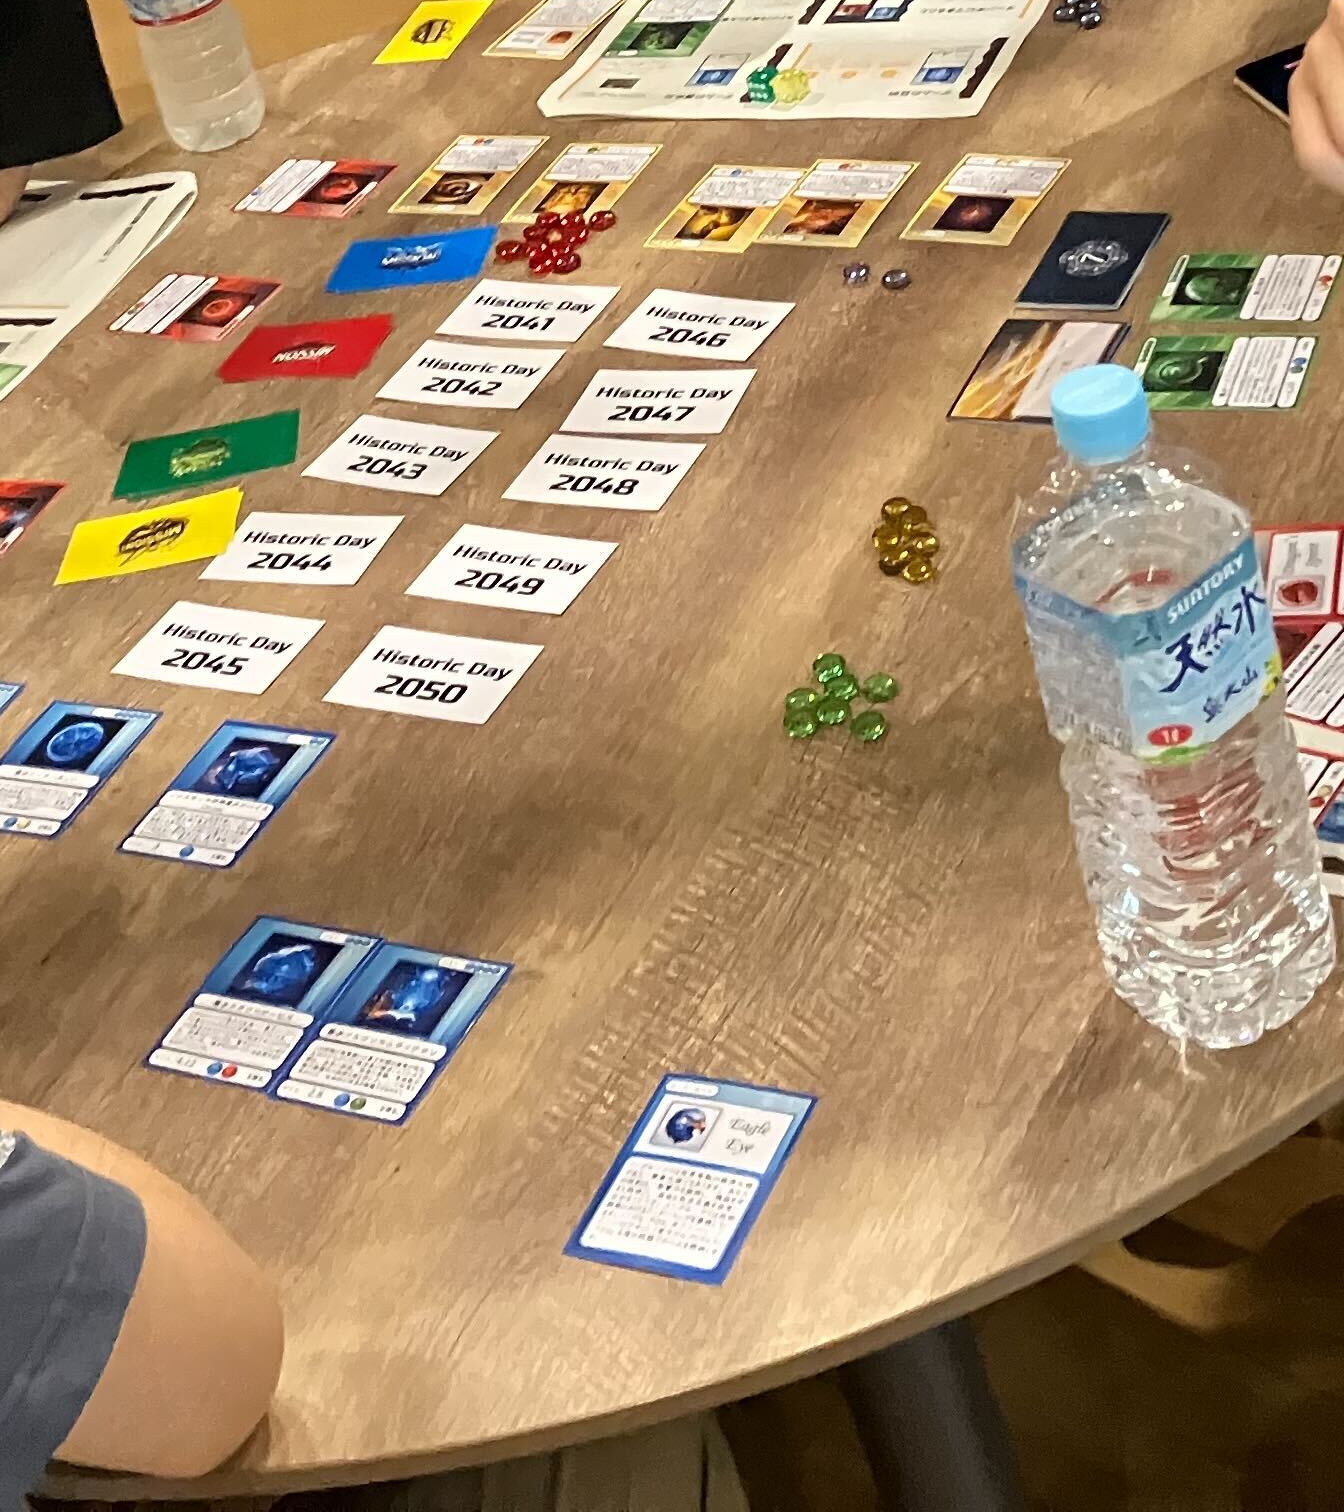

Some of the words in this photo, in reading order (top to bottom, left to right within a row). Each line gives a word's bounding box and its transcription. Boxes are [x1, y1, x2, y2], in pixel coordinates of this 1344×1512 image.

[474, 295, 553, 311] Historic
[556, 300, 595, 314] Day
[481, 313, 556, 332] 2041
[646, 306, 727, 326] Historic
[728, 316, 769, 331] Day
[648, 325, 731, 348] 2046
[417, 357, 497, 374] Historic
[500, 364, 541, 378] Day
[421, 376, 503, 396] 2042
[595, 386, 685, 399] Historic
[689, 388, 734, 401] Day
[607, 405, 697, 422] 2047
[347, 433, 427, 455] Historic
[428, 445, 469, 462] Day
[346, 455, 428, 480] 2043
[544, 453, 630, 471] Historic
[635, 460, 679, 475] Day
[548, 473, 640, 496] 2048
[243, 530, 331, 546] Historic
[332, 534, 377, 550] Day
[246, 552, 332, 572] 2044
[452, 545, 540, 570] Historic
[543, 557, 588, 576] Day
[454, 569, 545, 596] 2049
[1167, 552, 1244, 625] SUNTORY
[162, 623, 248, 647] Historic
[249, 636, 294, 655] Day
[1159, 585, 1267, 693] 天然水
[160, 648, 249, 676] 2045
[372, 647, 465, 673] Historic
[466, 662, 513, 682] Day
[374, 674, 469, 704] 2050
[728, 1117, 771, 1137] Eagle
